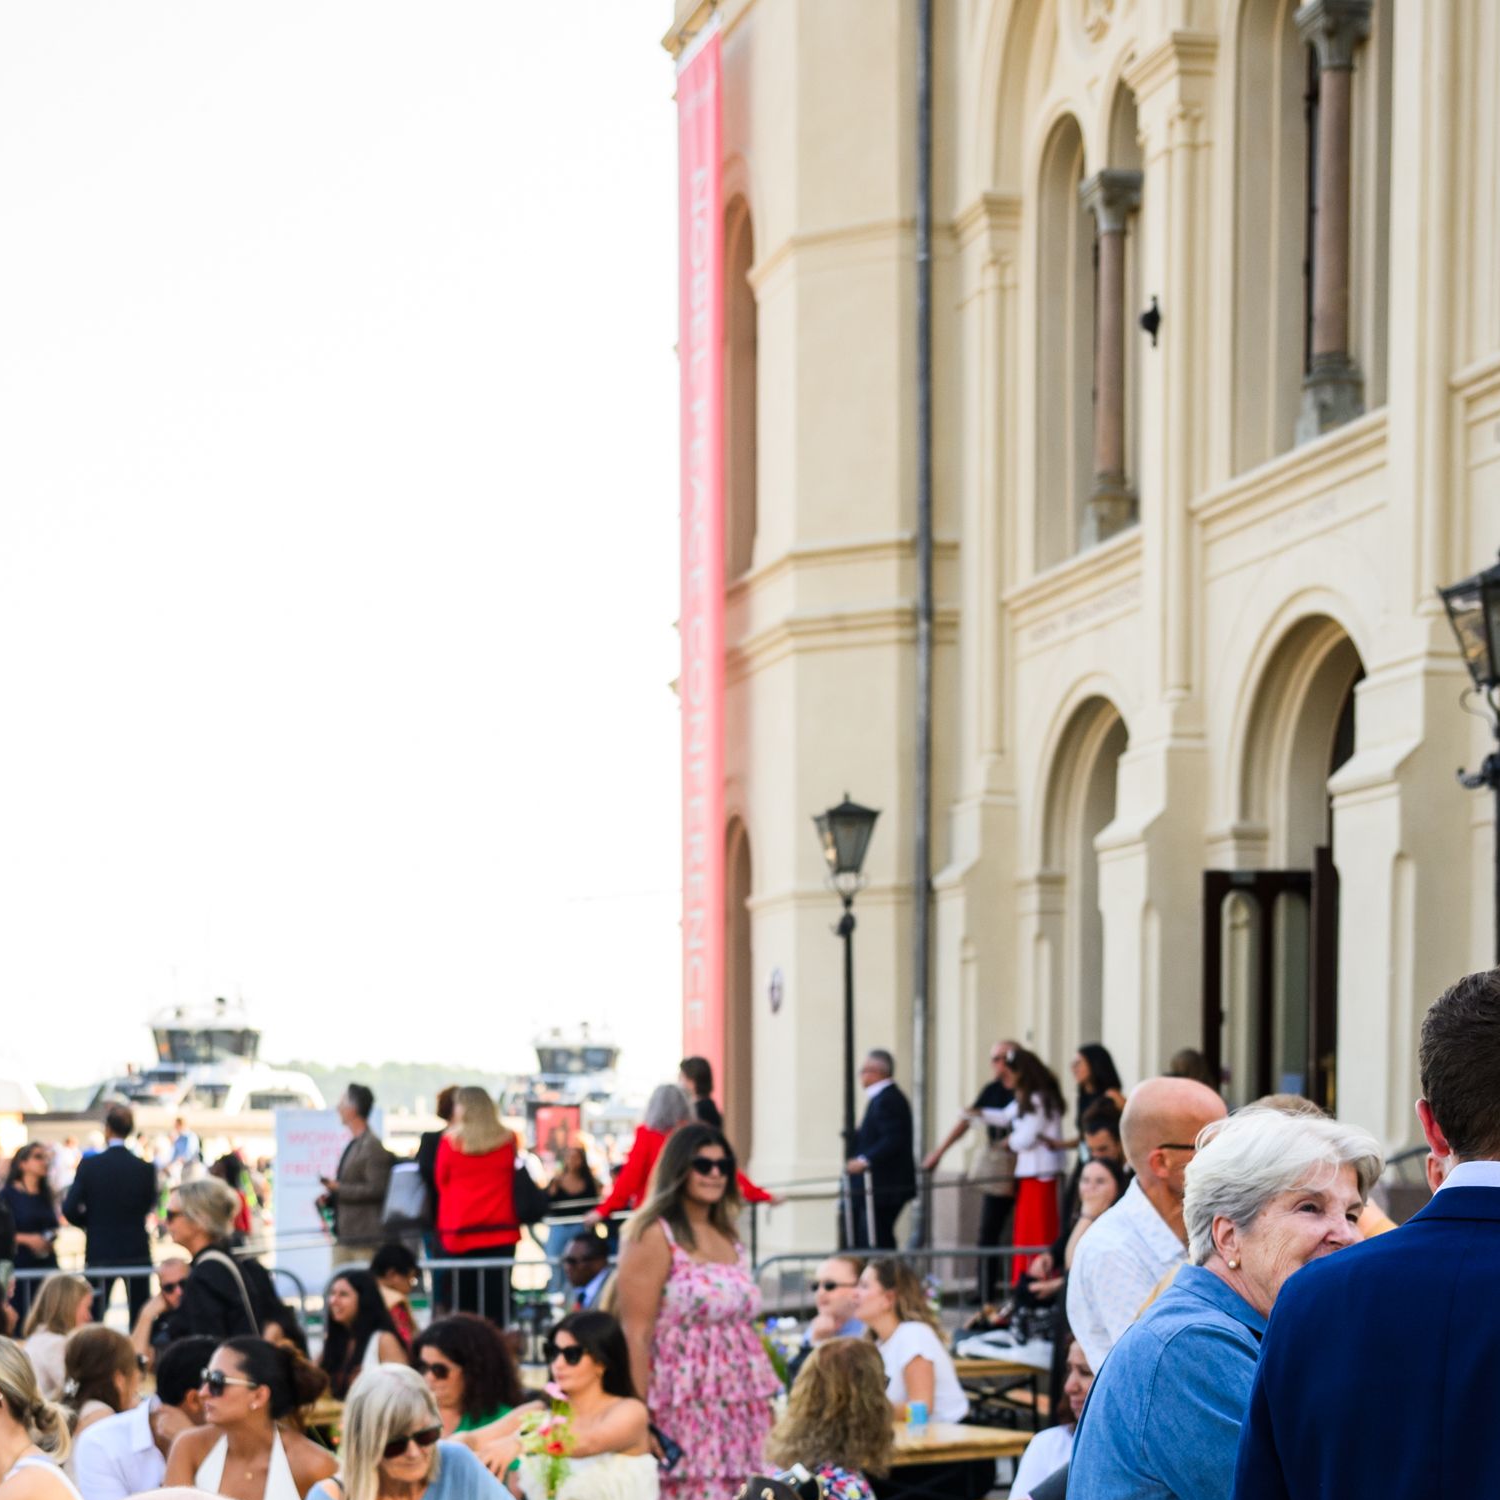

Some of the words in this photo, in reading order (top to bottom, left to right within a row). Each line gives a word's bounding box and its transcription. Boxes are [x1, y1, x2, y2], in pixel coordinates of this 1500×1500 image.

[690, 165, 708, 386] NOBEL
[688, 397, 707, 600] PEACE
[687, 614, 706, 1028] CONFERENCE
